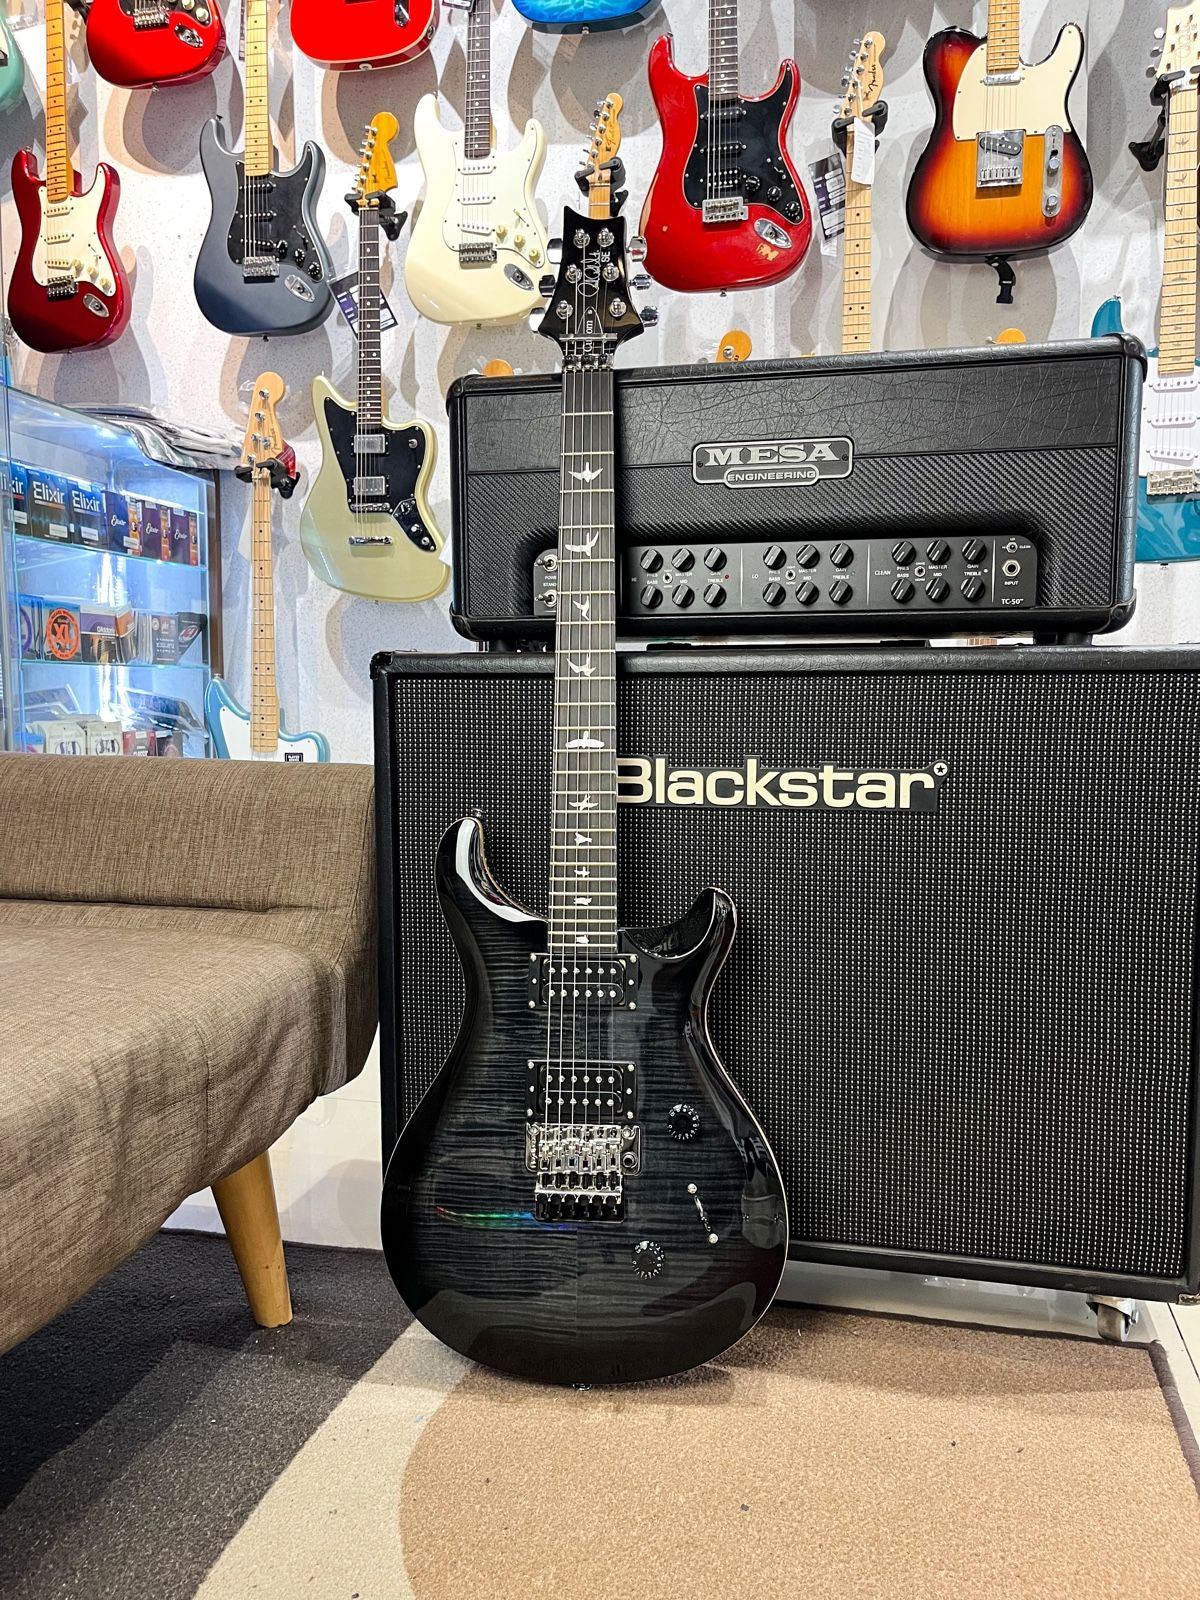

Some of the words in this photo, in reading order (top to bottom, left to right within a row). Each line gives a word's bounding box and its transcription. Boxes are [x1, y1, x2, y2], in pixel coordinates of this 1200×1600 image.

[867, 64, 879, 92] Fender
[601, 251, 611, 263] SE
[584, 320, 594, 353] Cuom
[704, 443, 840, 467] MESA
[727, 470, 817, 482] ENGINEERING
[32, 480, 66, 505] Elixir
[71, 489, 101, 513] Elixir
[616, 757, 935, 809] Blackstar
